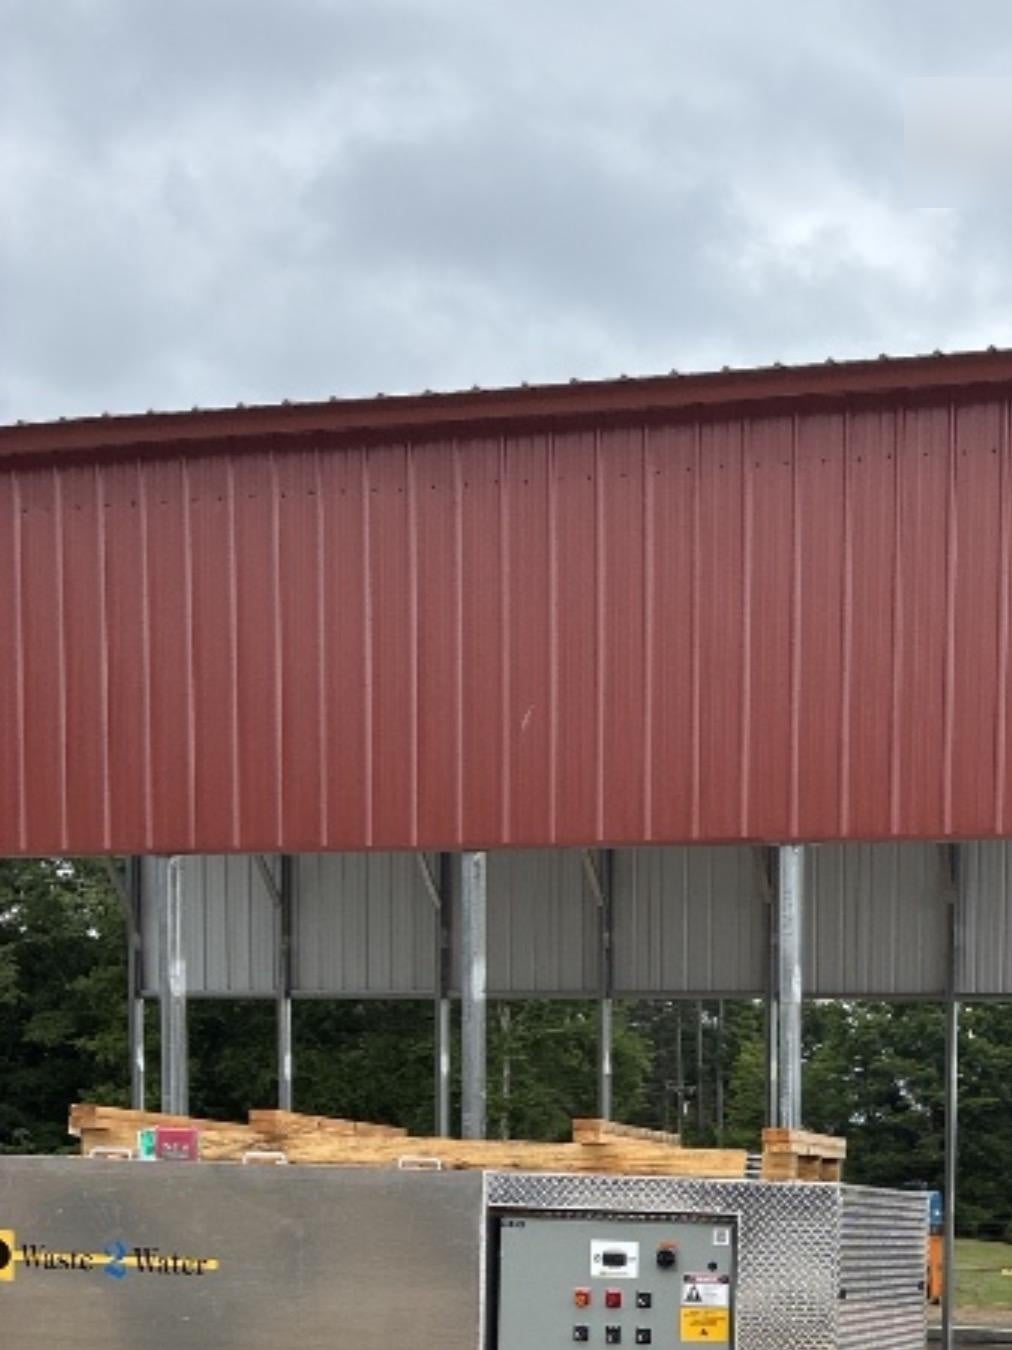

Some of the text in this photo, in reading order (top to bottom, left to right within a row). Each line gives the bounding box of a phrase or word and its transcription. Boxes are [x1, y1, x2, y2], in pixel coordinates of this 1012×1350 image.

[22, 1237, 208, 1280] Waste 2 Water
